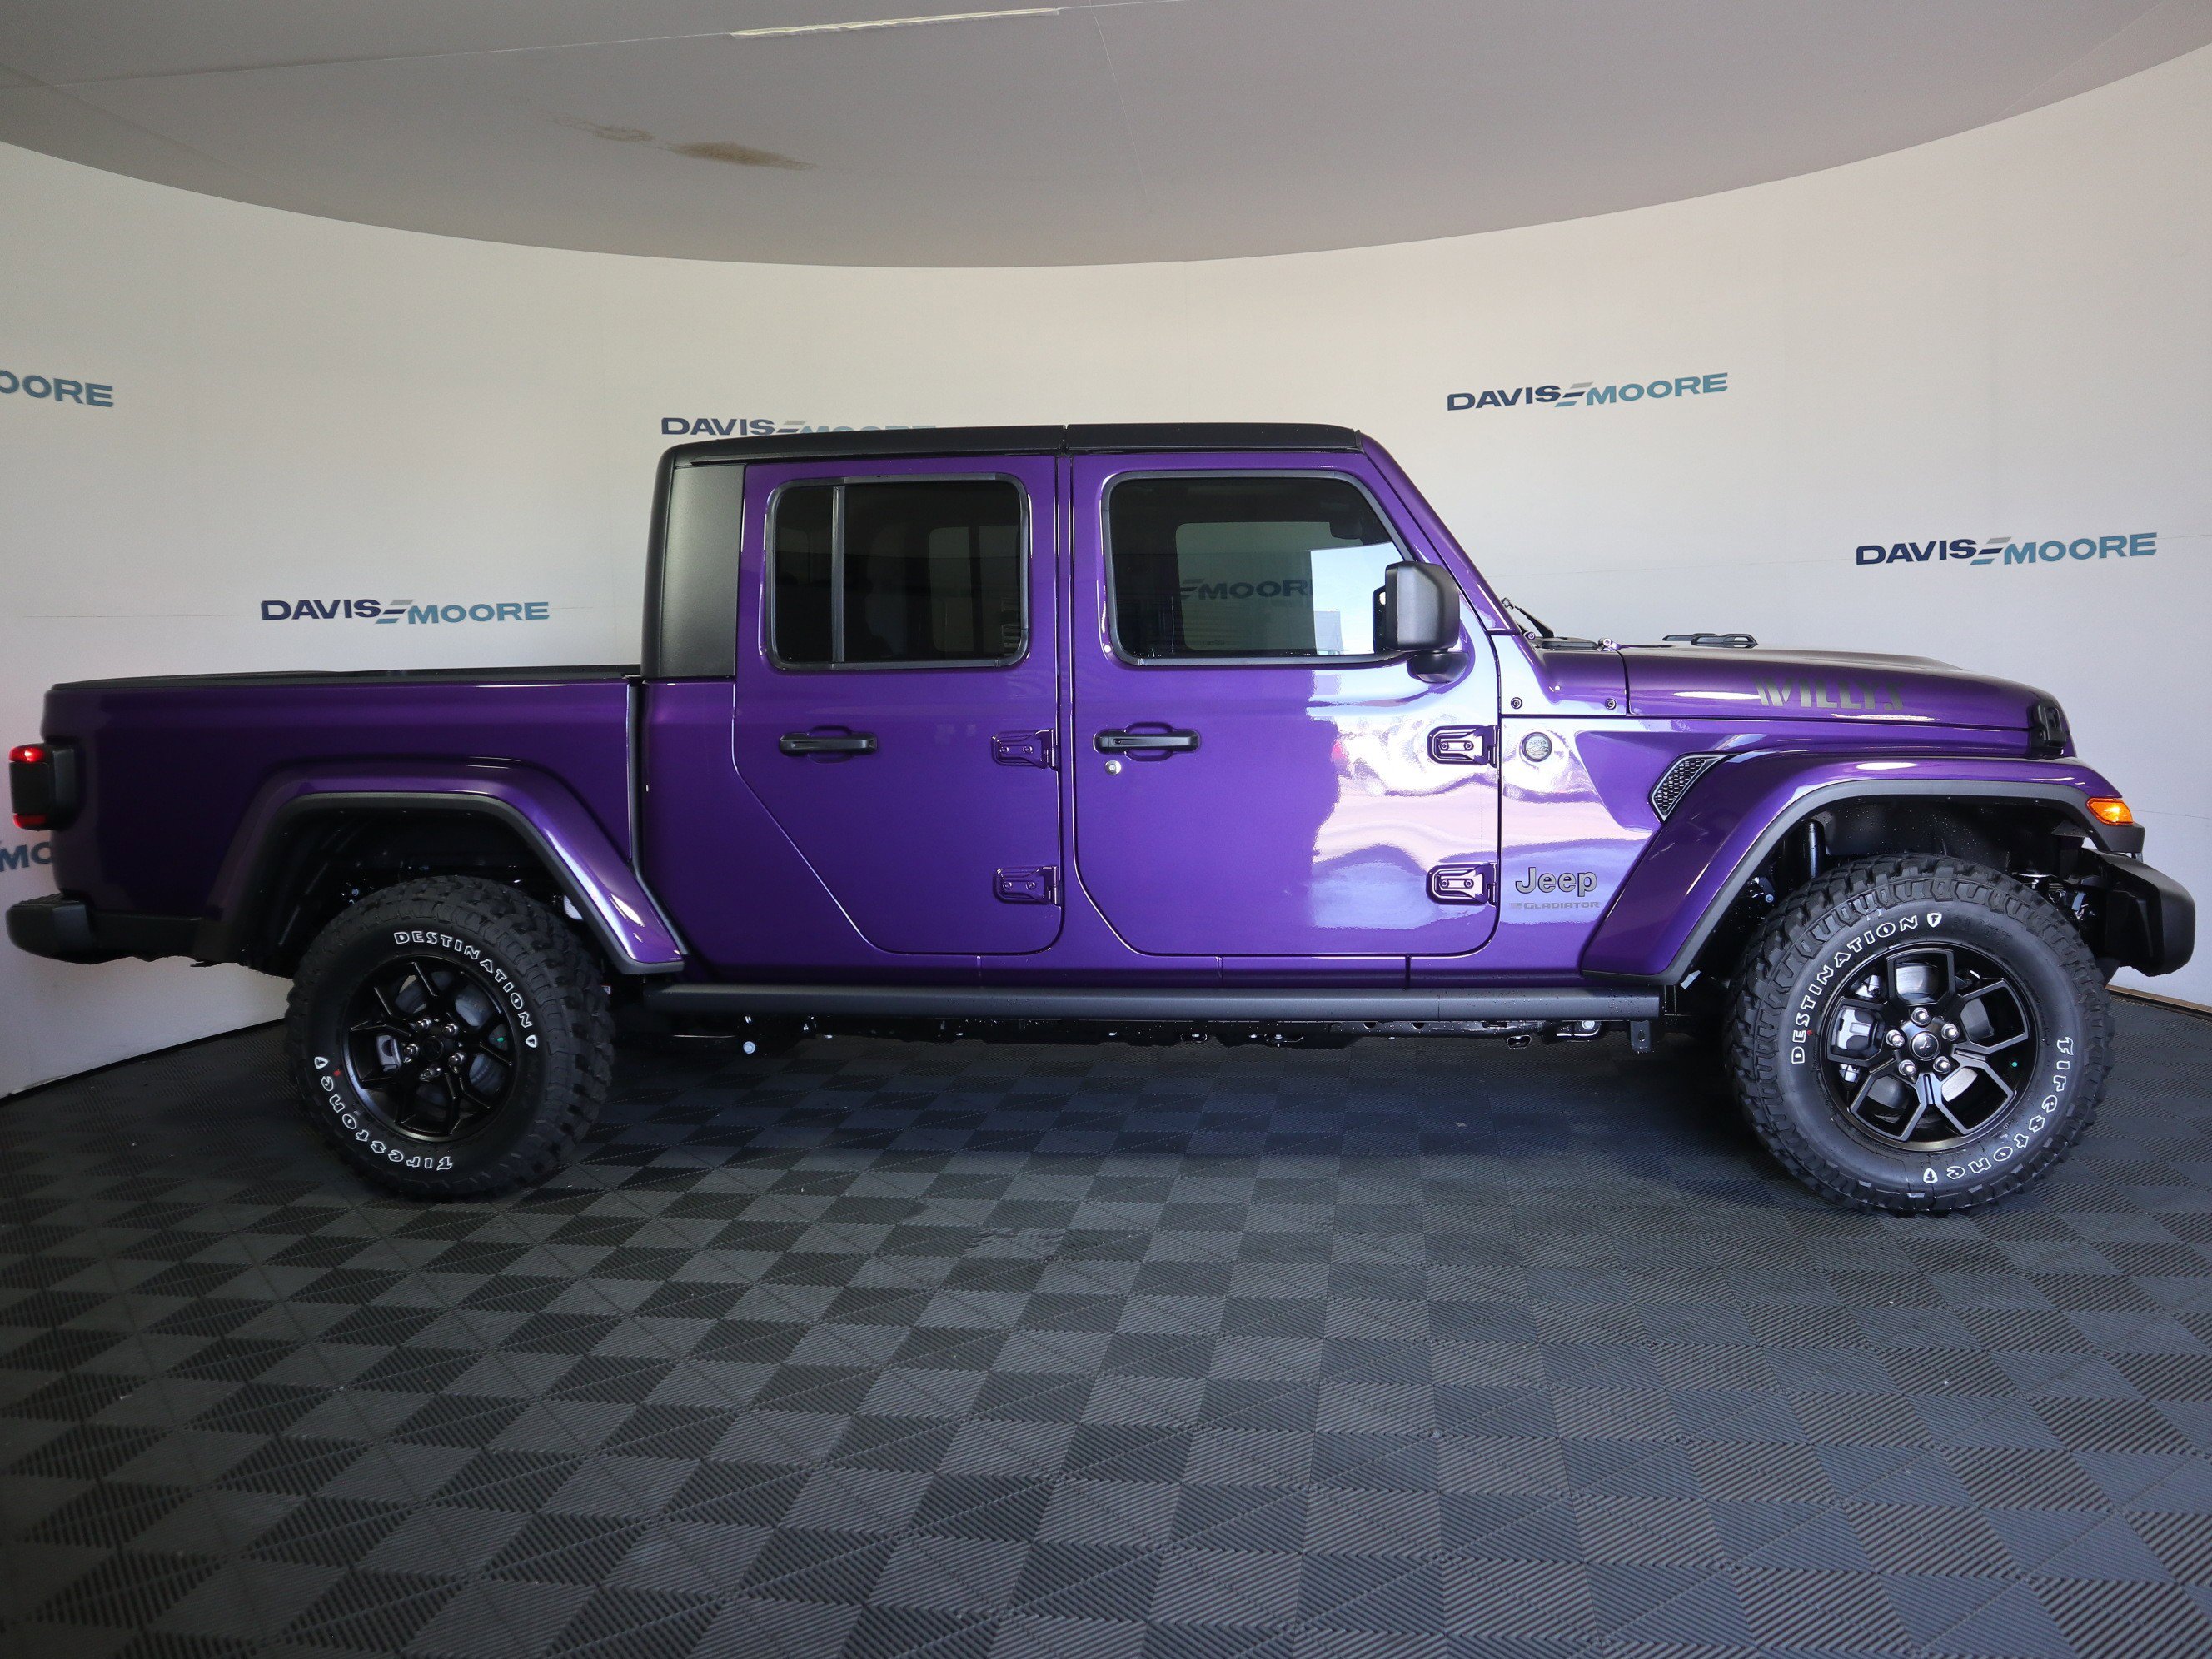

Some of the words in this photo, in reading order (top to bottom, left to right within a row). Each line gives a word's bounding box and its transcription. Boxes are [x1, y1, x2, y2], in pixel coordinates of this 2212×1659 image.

[0, 370, 113, 407] OORE
[1447, 385, 1562, 411] DAVIS
[1587, 372, 1728, 406] MOORE
[661, 416, 775, 436] DAVIS
[1856, 538, 1978, 565] DAVIS
[2004, 532, 2157, 565] MOORE
[1198, 578, 1313, 600] MOOR
[261, 599, 381, 620] DAVIS
[407, 601, 551, 625] MOORE
[1752, 677, 1905, 710] WILLYS
[1515, 867, 1598, 897] Jeep
[1523, 901, 1600, 909] GLADIATOR
[394, 931, 532, 1029] DESTINATION
[1791, 914, 1918, 1064] DESTINATION
